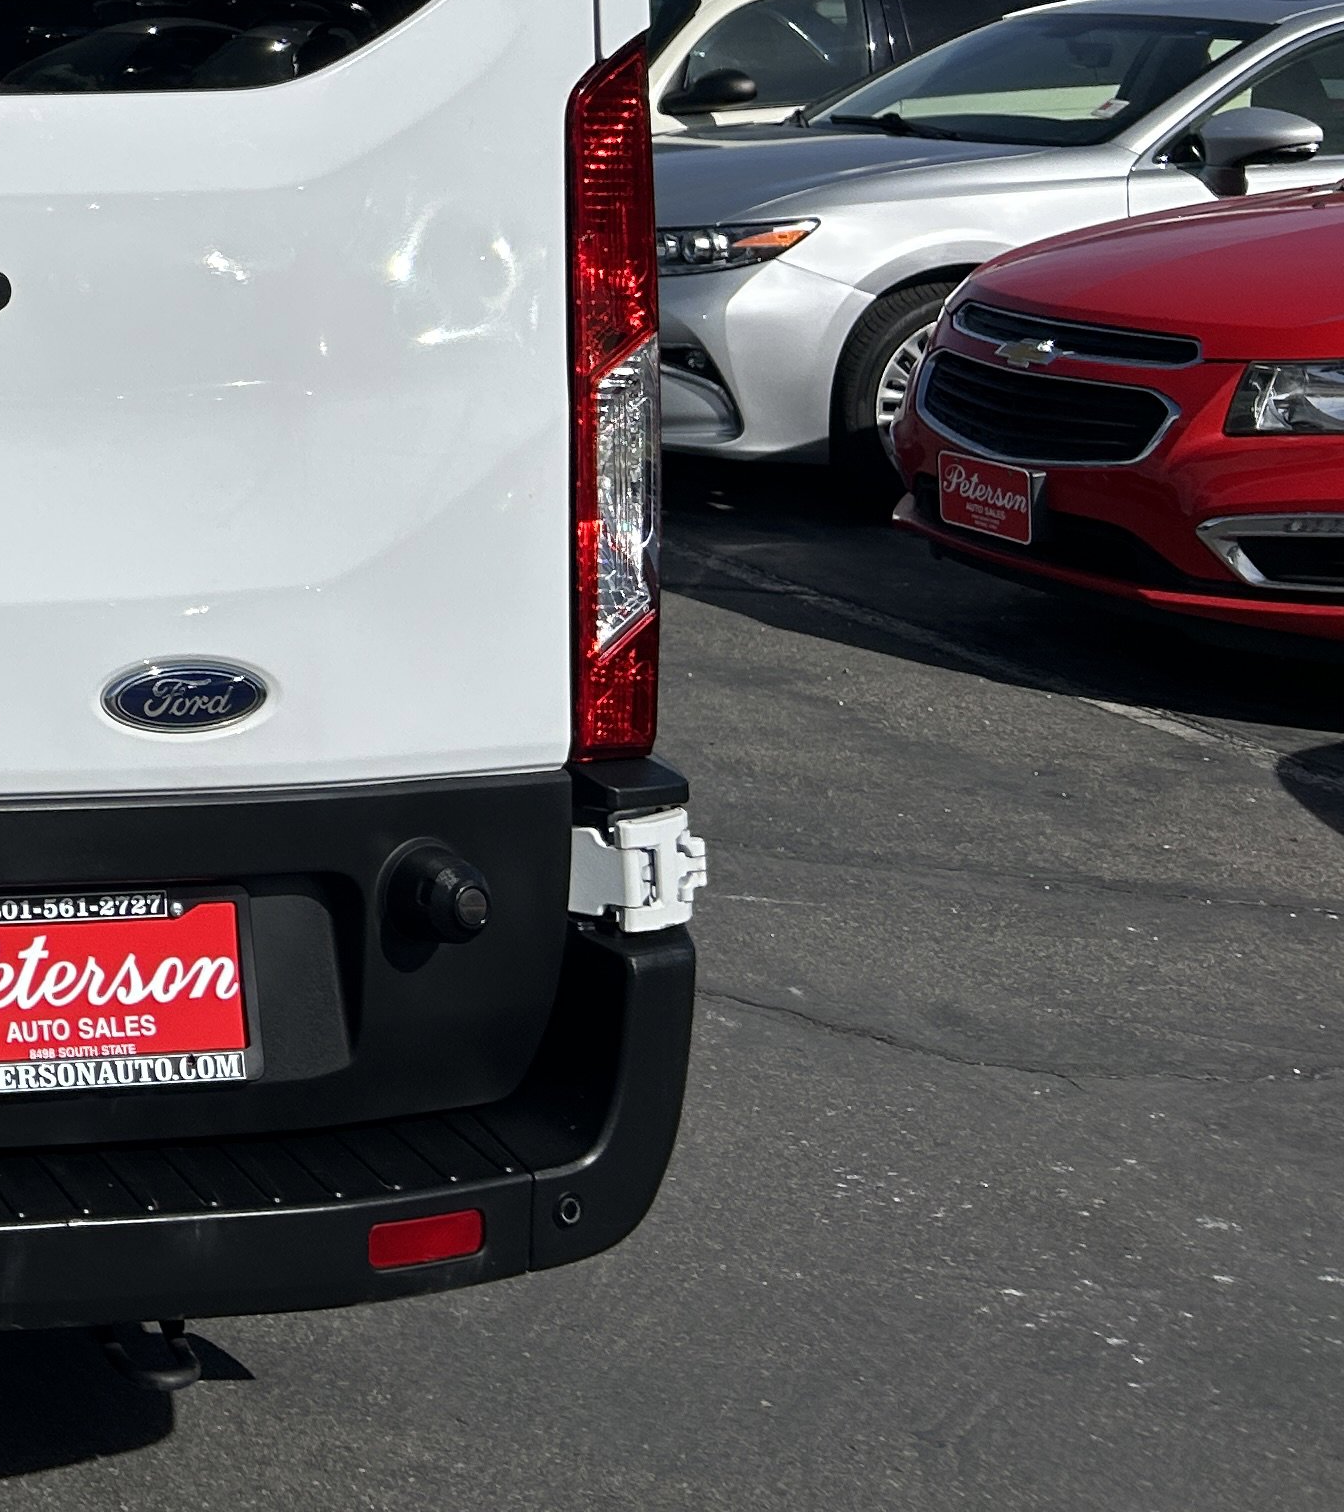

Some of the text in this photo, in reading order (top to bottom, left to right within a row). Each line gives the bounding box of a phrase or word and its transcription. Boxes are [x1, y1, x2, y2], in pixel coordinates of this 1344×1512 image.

[942, 463, 1027, 514] Peterson
[143, 678, 234, 717] Ford
[6, 1014, 157, 1044] AUTO SALES
[58, 1045, 99, 1059] SOUTH
[101, 1043, 137, 1056] STATE
